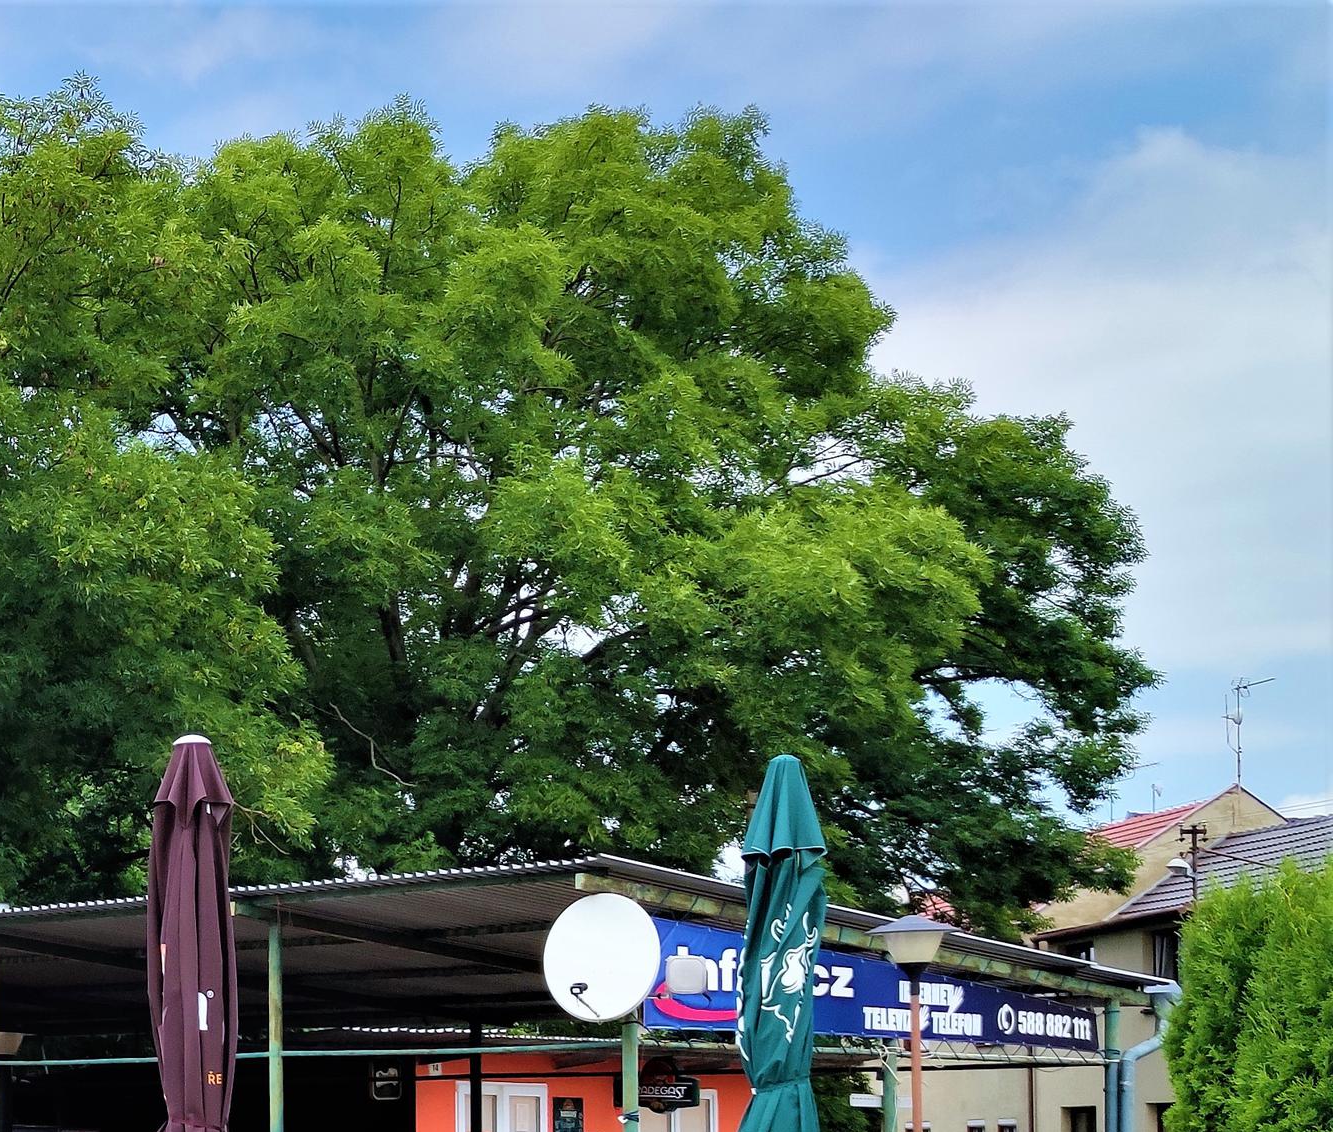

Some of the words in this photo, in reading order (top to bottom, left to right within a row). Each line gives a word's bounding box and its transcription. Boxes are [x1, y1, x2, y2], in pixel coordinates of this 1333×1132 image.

[931, 1010, 984, 1038] TELEFON
[1017, 1009, 1045, 1036] 588
[1045, 1013, 1072, 1038] 882
[1073, 1016, 1091, 1041] 111
